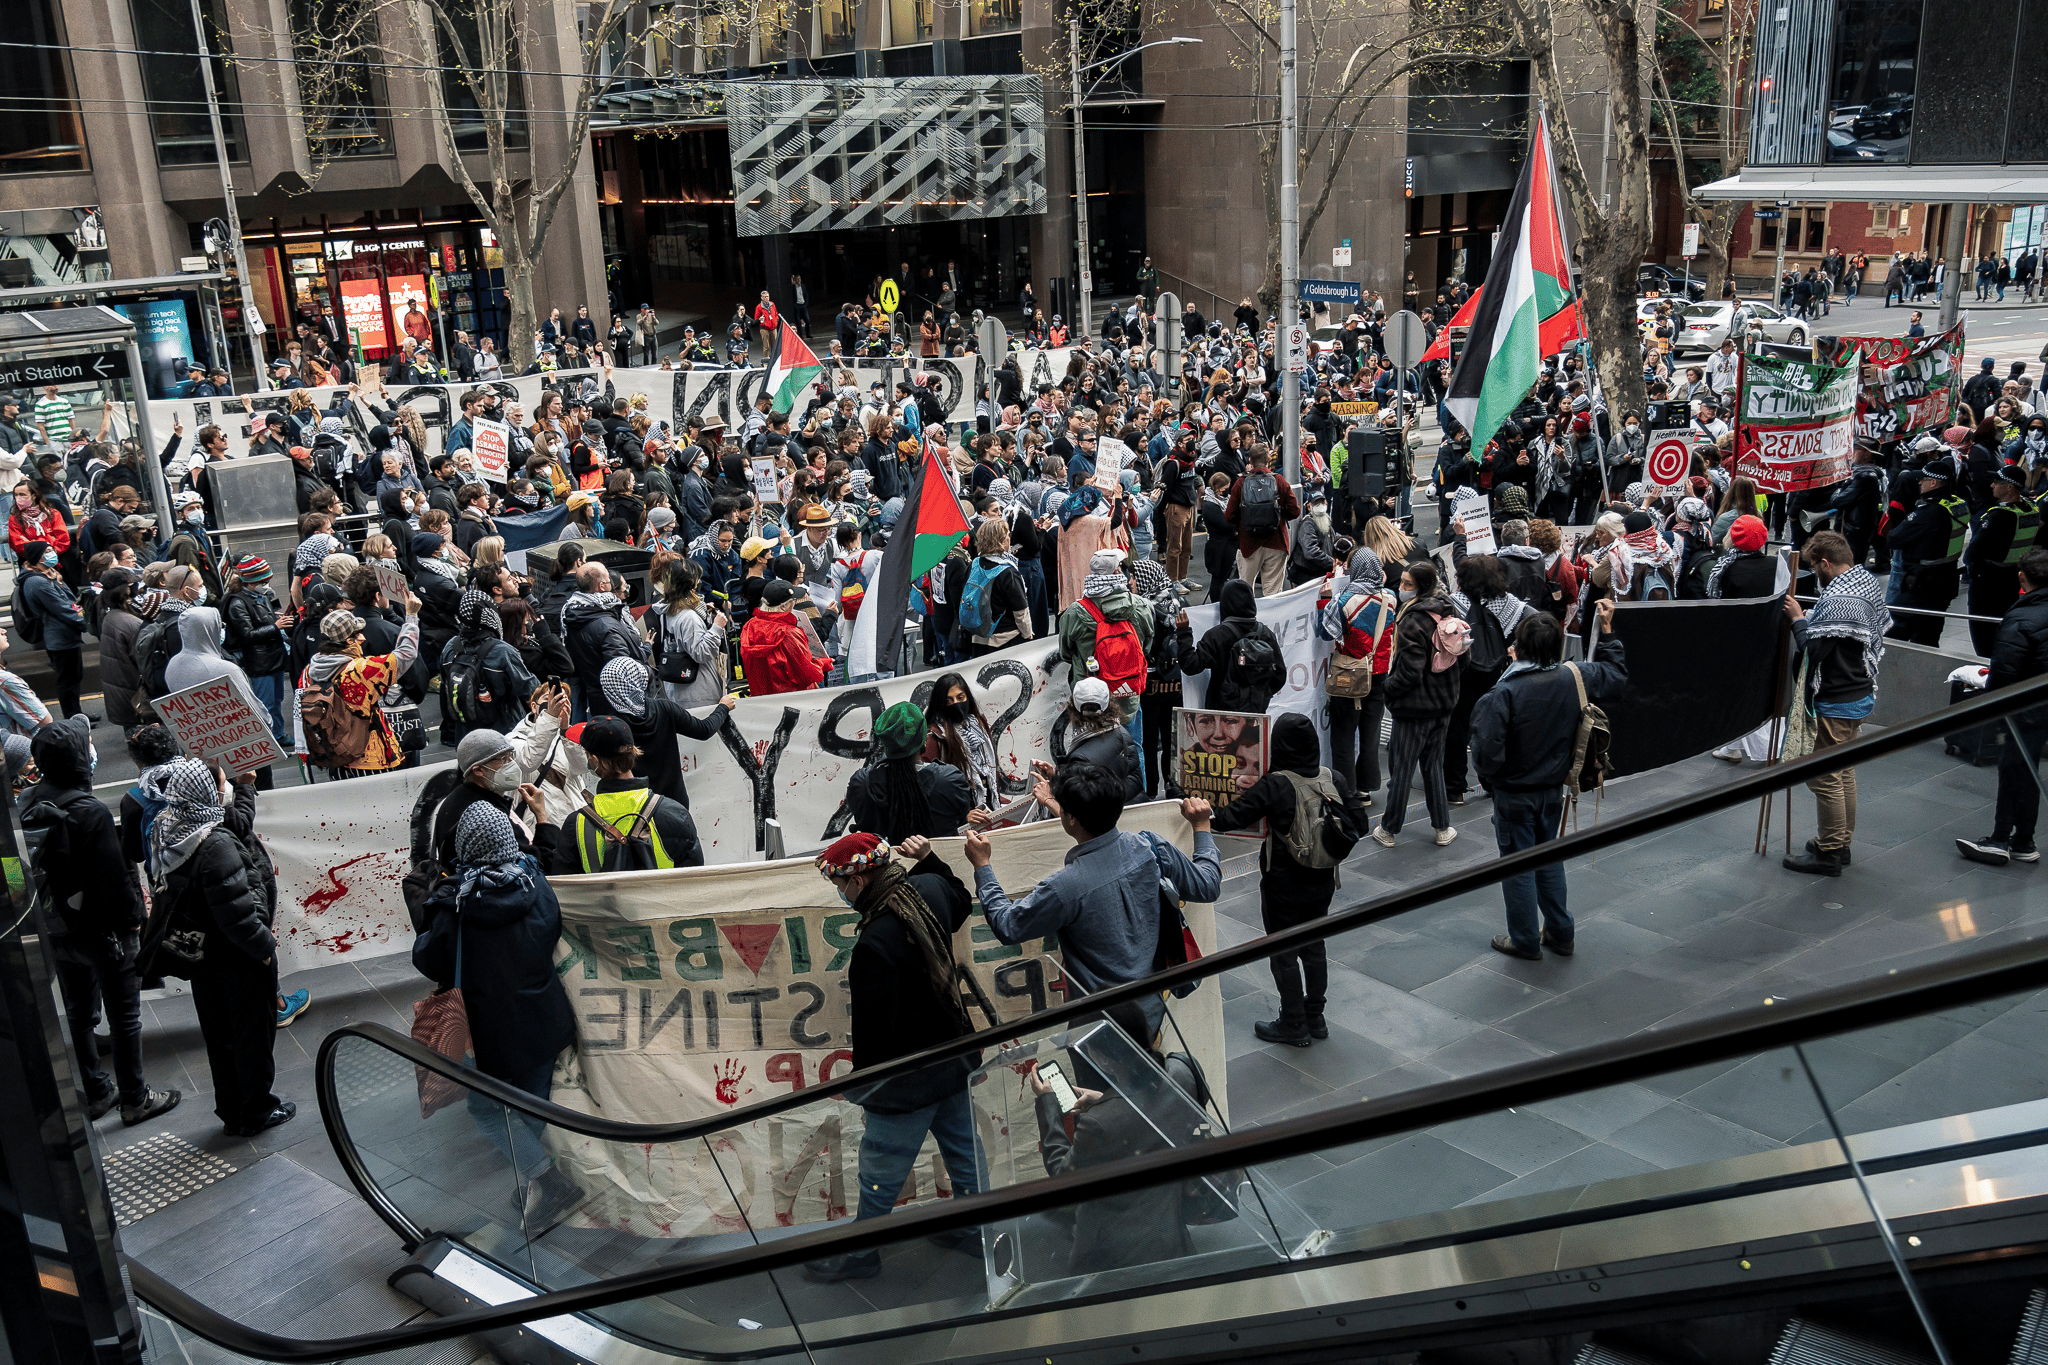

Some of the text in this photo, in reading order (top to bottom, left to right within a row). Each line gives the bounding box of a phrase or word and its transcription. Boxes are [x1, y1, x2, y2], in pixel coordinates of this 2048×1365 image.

[388, 240, 425, 251] CENTRE
[447, 273, 473, 282] CRUISE
[451, 280, 471, 288] SALE
[1309, 284, 1359, 299] Goldsbrough La
[151, 319, 164, 327] big
[25, 364, 83, 381] Station
[1330, 403, 1373, 415] WARNING
[483, 433, 500, 443] STOP
[1654, 431, 1676, 441] Health
[476, 440, 506, 453] ISRAEL'S
[476, 448, 505, 459] GENOCIDE
[481, 456, 501, 467] NOW!
[1147, 679, 1182, 696] Juic
[160, 681, 232, 719] MILITARY
[173, 697, 245, 730] INDUSTRIAL
[177, 720, 217, 742] DEATH
[188, 720, 263, 755] SPONSORED
[224, 740, 276, 765] LABOR
[1183, 750, 1237, 777] STOP
[1184, 774, 1237, 793] ARMING
